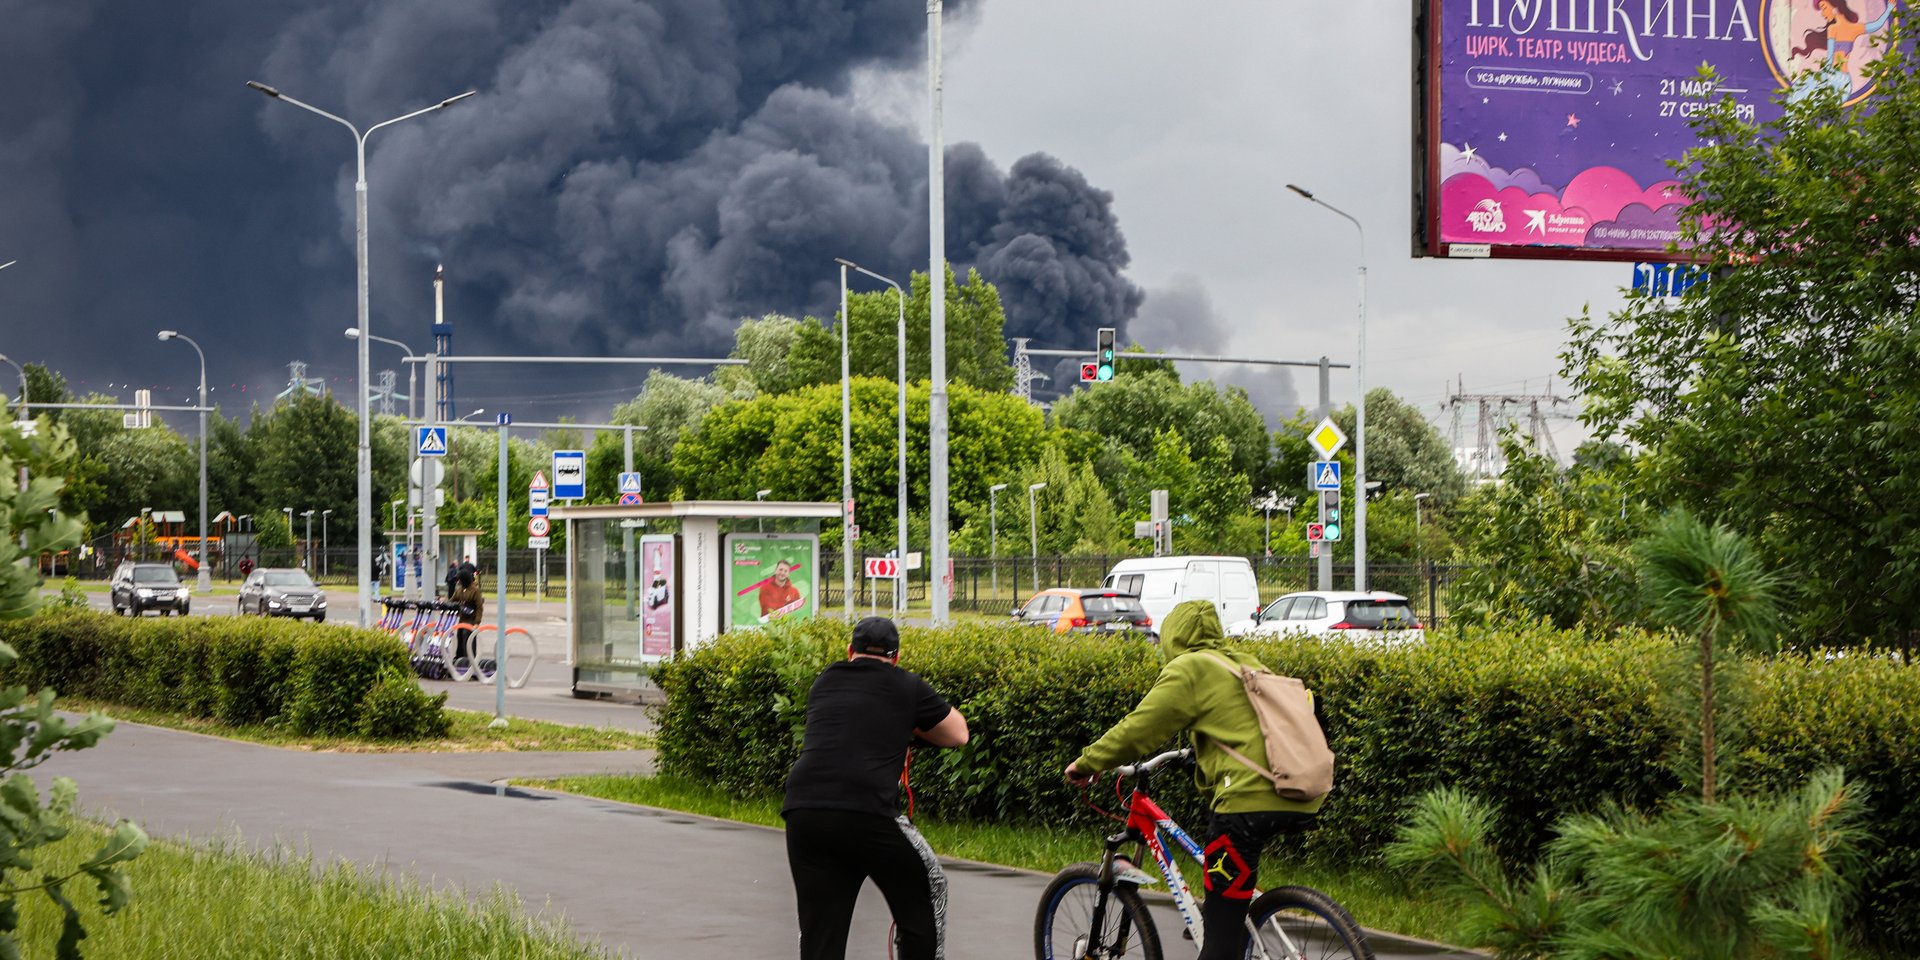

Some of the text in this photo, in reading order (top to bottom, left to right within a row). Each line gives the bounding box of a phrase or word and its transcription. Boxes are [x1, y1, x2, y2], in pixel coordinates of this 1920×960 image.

[1465, 34, 1631, 64] ЦИРК. ТЕАТР. ЧУДЕСА.
[1541, 76, 1582, 88] ЛУЖНИКИ
[1660, 79, 1676, 96] 21
[1660, 101, 1677, 117] 27
[533, 522, 546, 530] 40
